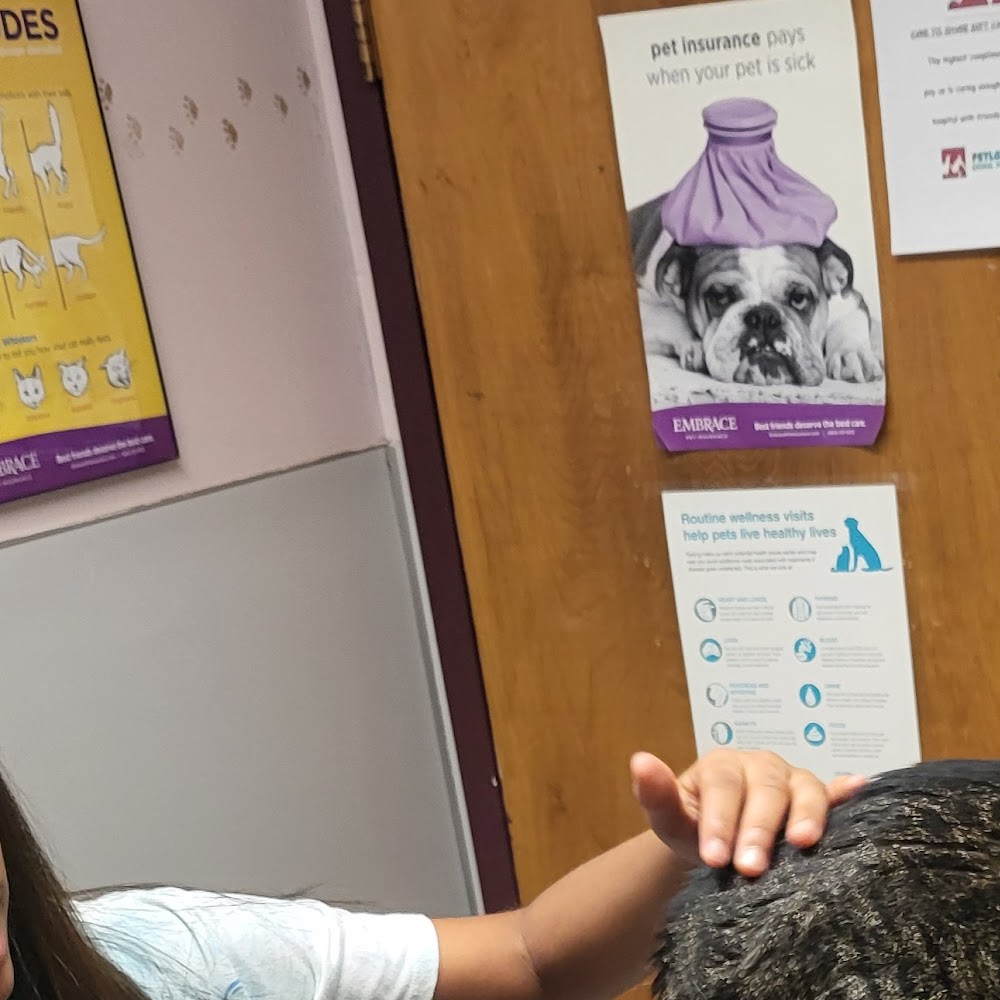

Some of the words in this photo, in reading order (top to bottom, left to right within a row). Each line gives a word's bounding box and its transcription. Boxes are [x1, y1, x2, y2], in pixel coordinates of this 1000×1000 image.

[0, 9, 59, 40] DES
[650, 39, 677, 62] pet
[682, 32, 761, 55] insurance
[767, 27, 806, 49] pays
[646, 67, 691, 86] when
[694, 64, 730, 84] your
[735, 58, 763, 80] pet
[767, 54, 780, 75] is
[785, 51, 816, 74] sick
[672, 416, 738, 433] EMBRACE
[681, 513, 726, 525] Routine
[729, 511, 780, 523] wellness
[783, 511, 815, 522] visits
[683, 530, 709, 543] help
[712, 529, 737, 543] pets
[740, 528, 760, 540] live
[763, 527, 806, 541] healthy
[809, 526, 837, 539] lives
